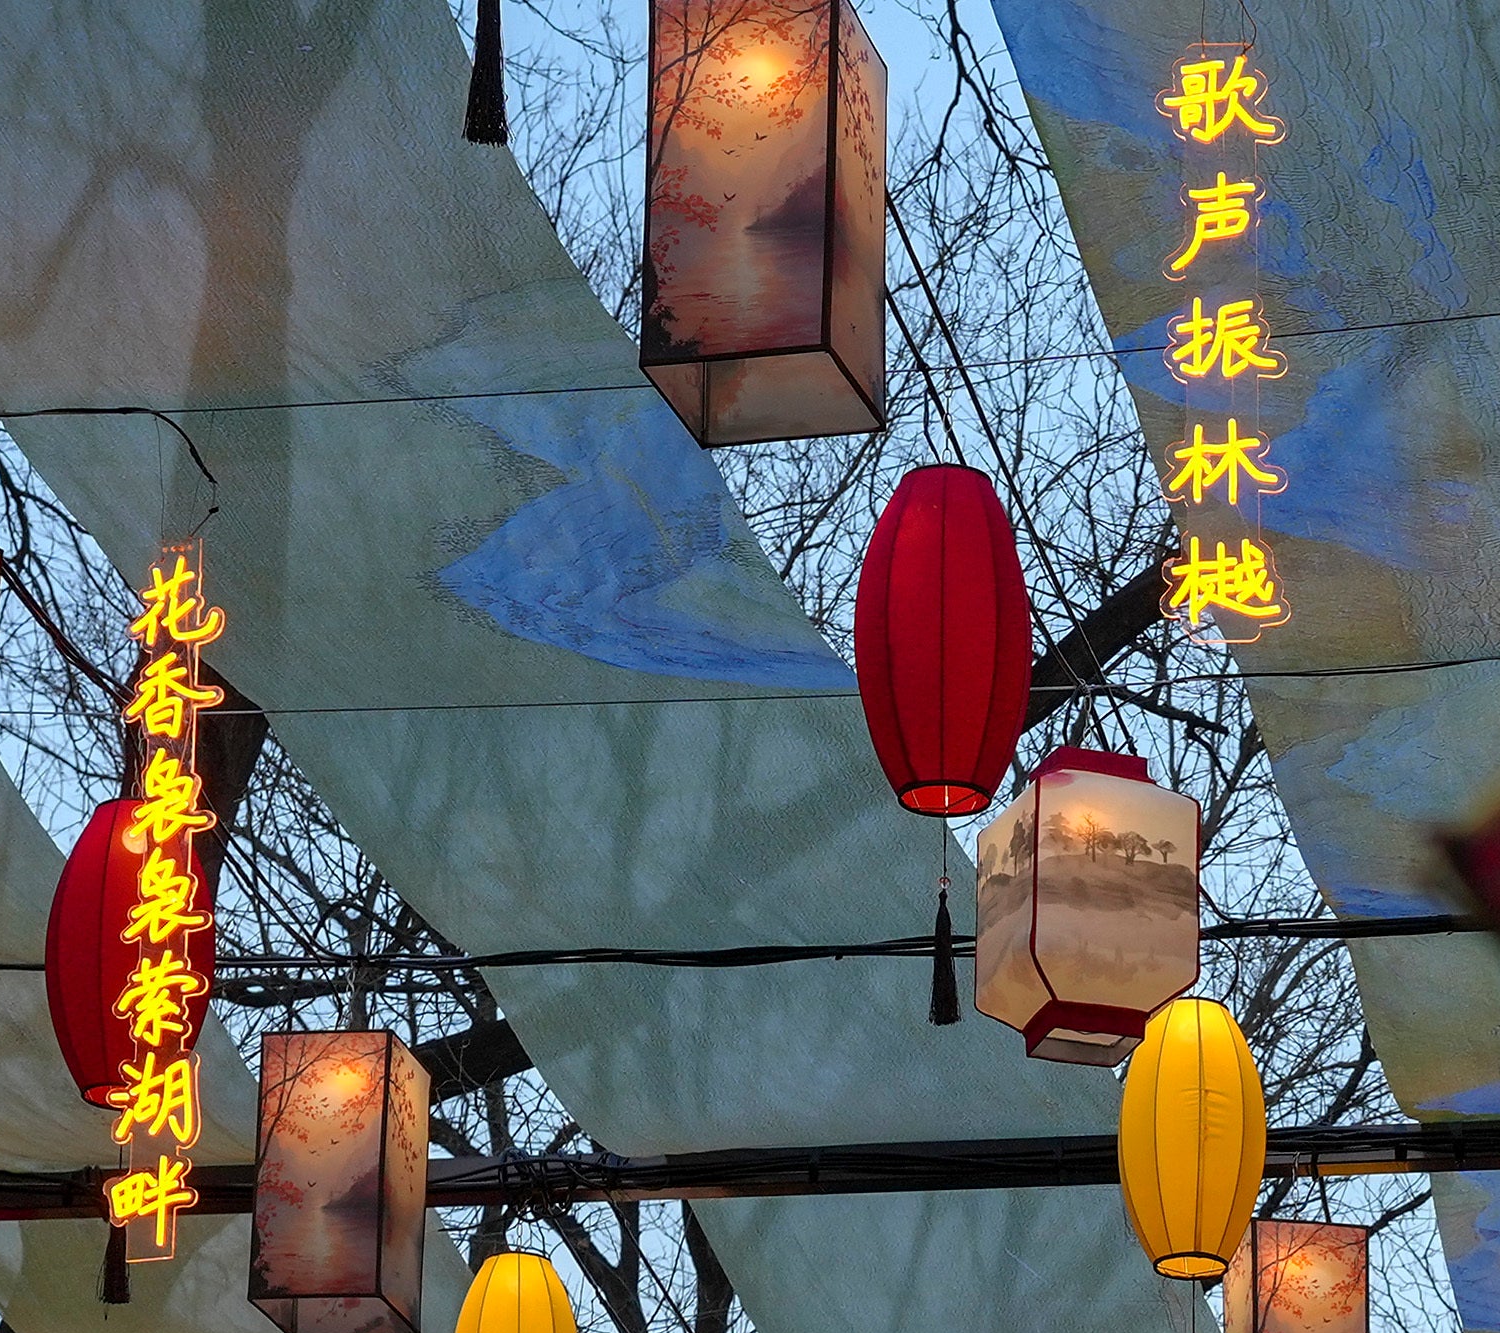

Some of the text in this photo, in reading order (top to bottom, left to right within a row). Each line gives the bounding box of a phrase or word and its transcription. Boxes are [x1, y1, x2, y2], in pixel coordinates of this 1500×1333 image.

[1165, 55, 1283, 627] 歌声振林樾
[109, 555, 223, 1247] 花香袅袅萦湖畔
